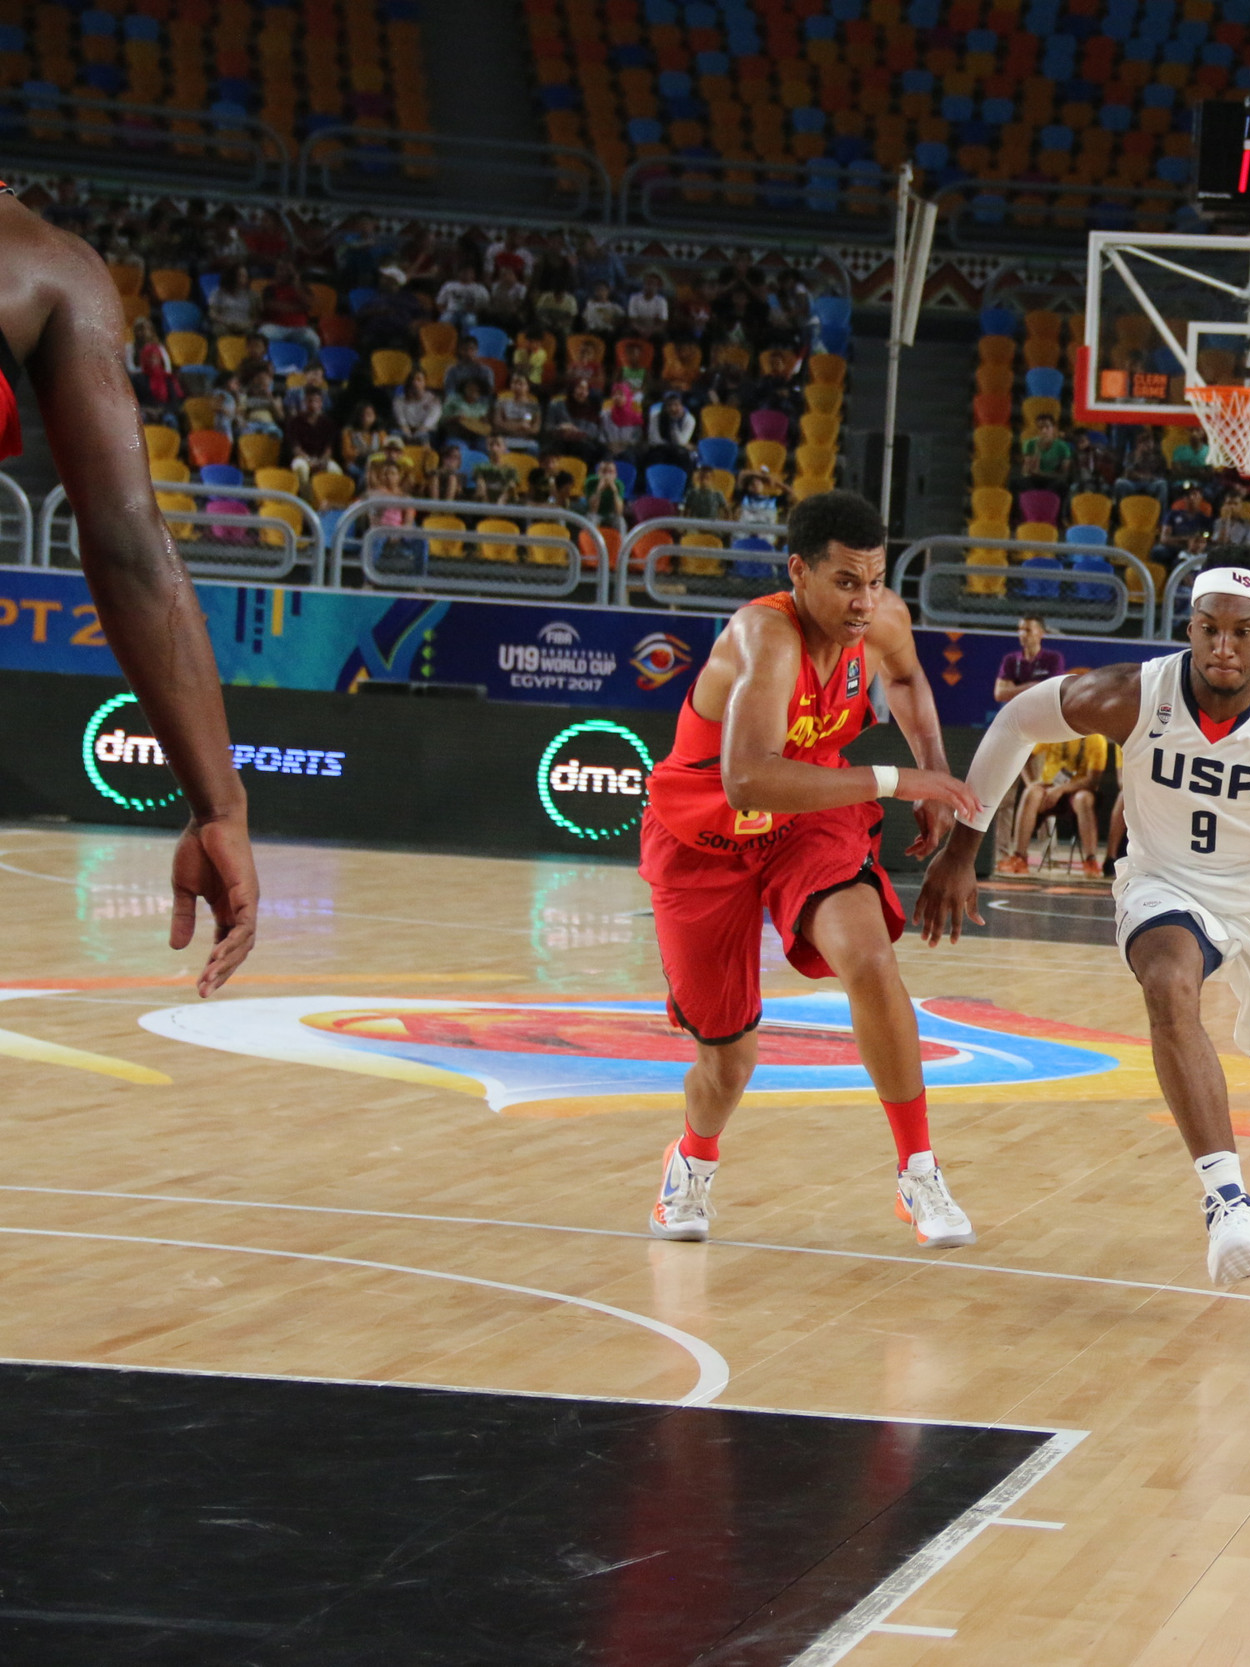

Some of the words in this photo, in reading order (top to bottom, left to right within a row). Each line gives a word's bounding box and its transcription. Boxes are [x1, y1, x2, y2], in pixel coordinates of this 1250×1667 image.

[545, 630, 573, 646] FIBA
[499, 643, 540, 672] U19
[541, 658, 588, 674] WORLD
[589, 660, 617, 677] CUP
[510, 673, 566, 689] EGYPT
[567, 678, 604, 692] 2017
[95, 729, 170, 766] dm
[228, 745, 346, 777] PORTS
[549, 759, 643, 795] dmc
[1191, 810, 1217, 854] 9
